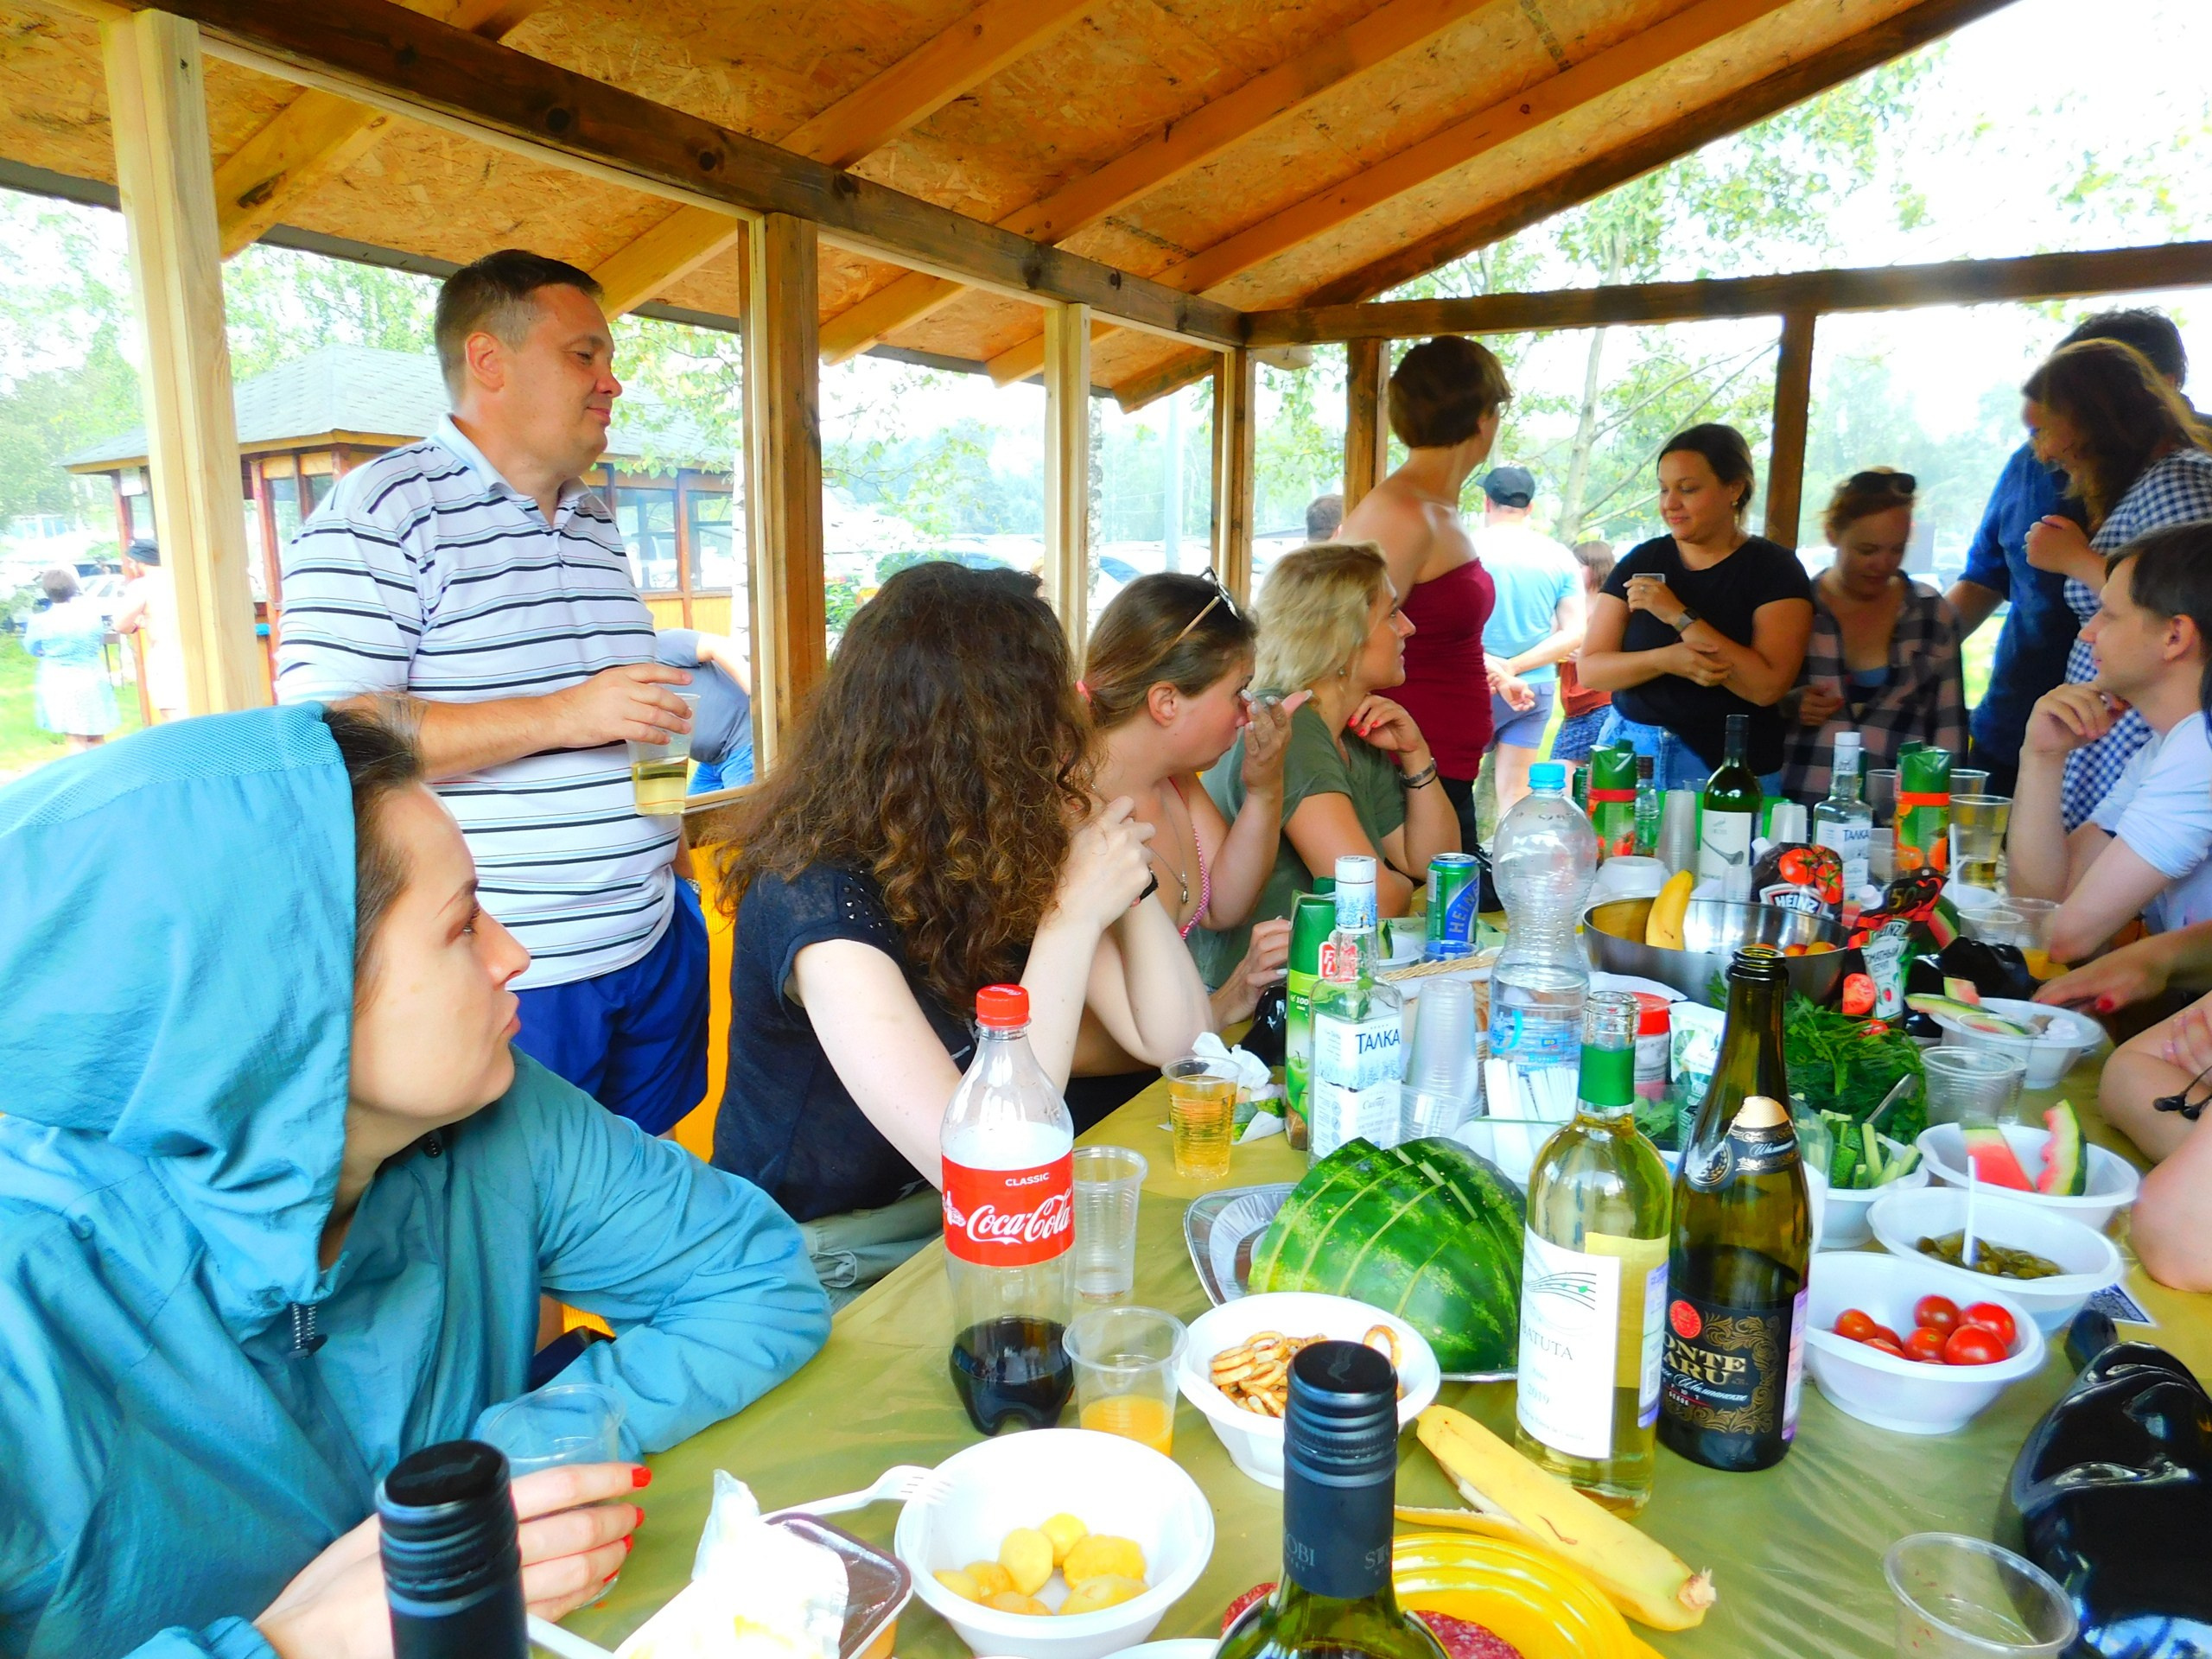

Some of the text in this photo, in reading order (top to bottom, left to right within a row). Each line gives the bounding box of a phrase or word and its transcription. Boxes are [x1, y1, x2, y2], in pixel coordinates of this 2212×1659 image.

[1774, 894, 1819, 914] HEINZ
[1356, 1028, 1401, 1054] ТАЛКА
[1005, 1172, 1050, 1187] CLASSIC
[966, 1188, 1071, 1245] Coca-Cola
[1522, 1319, 1573, 1361] BATUTA
